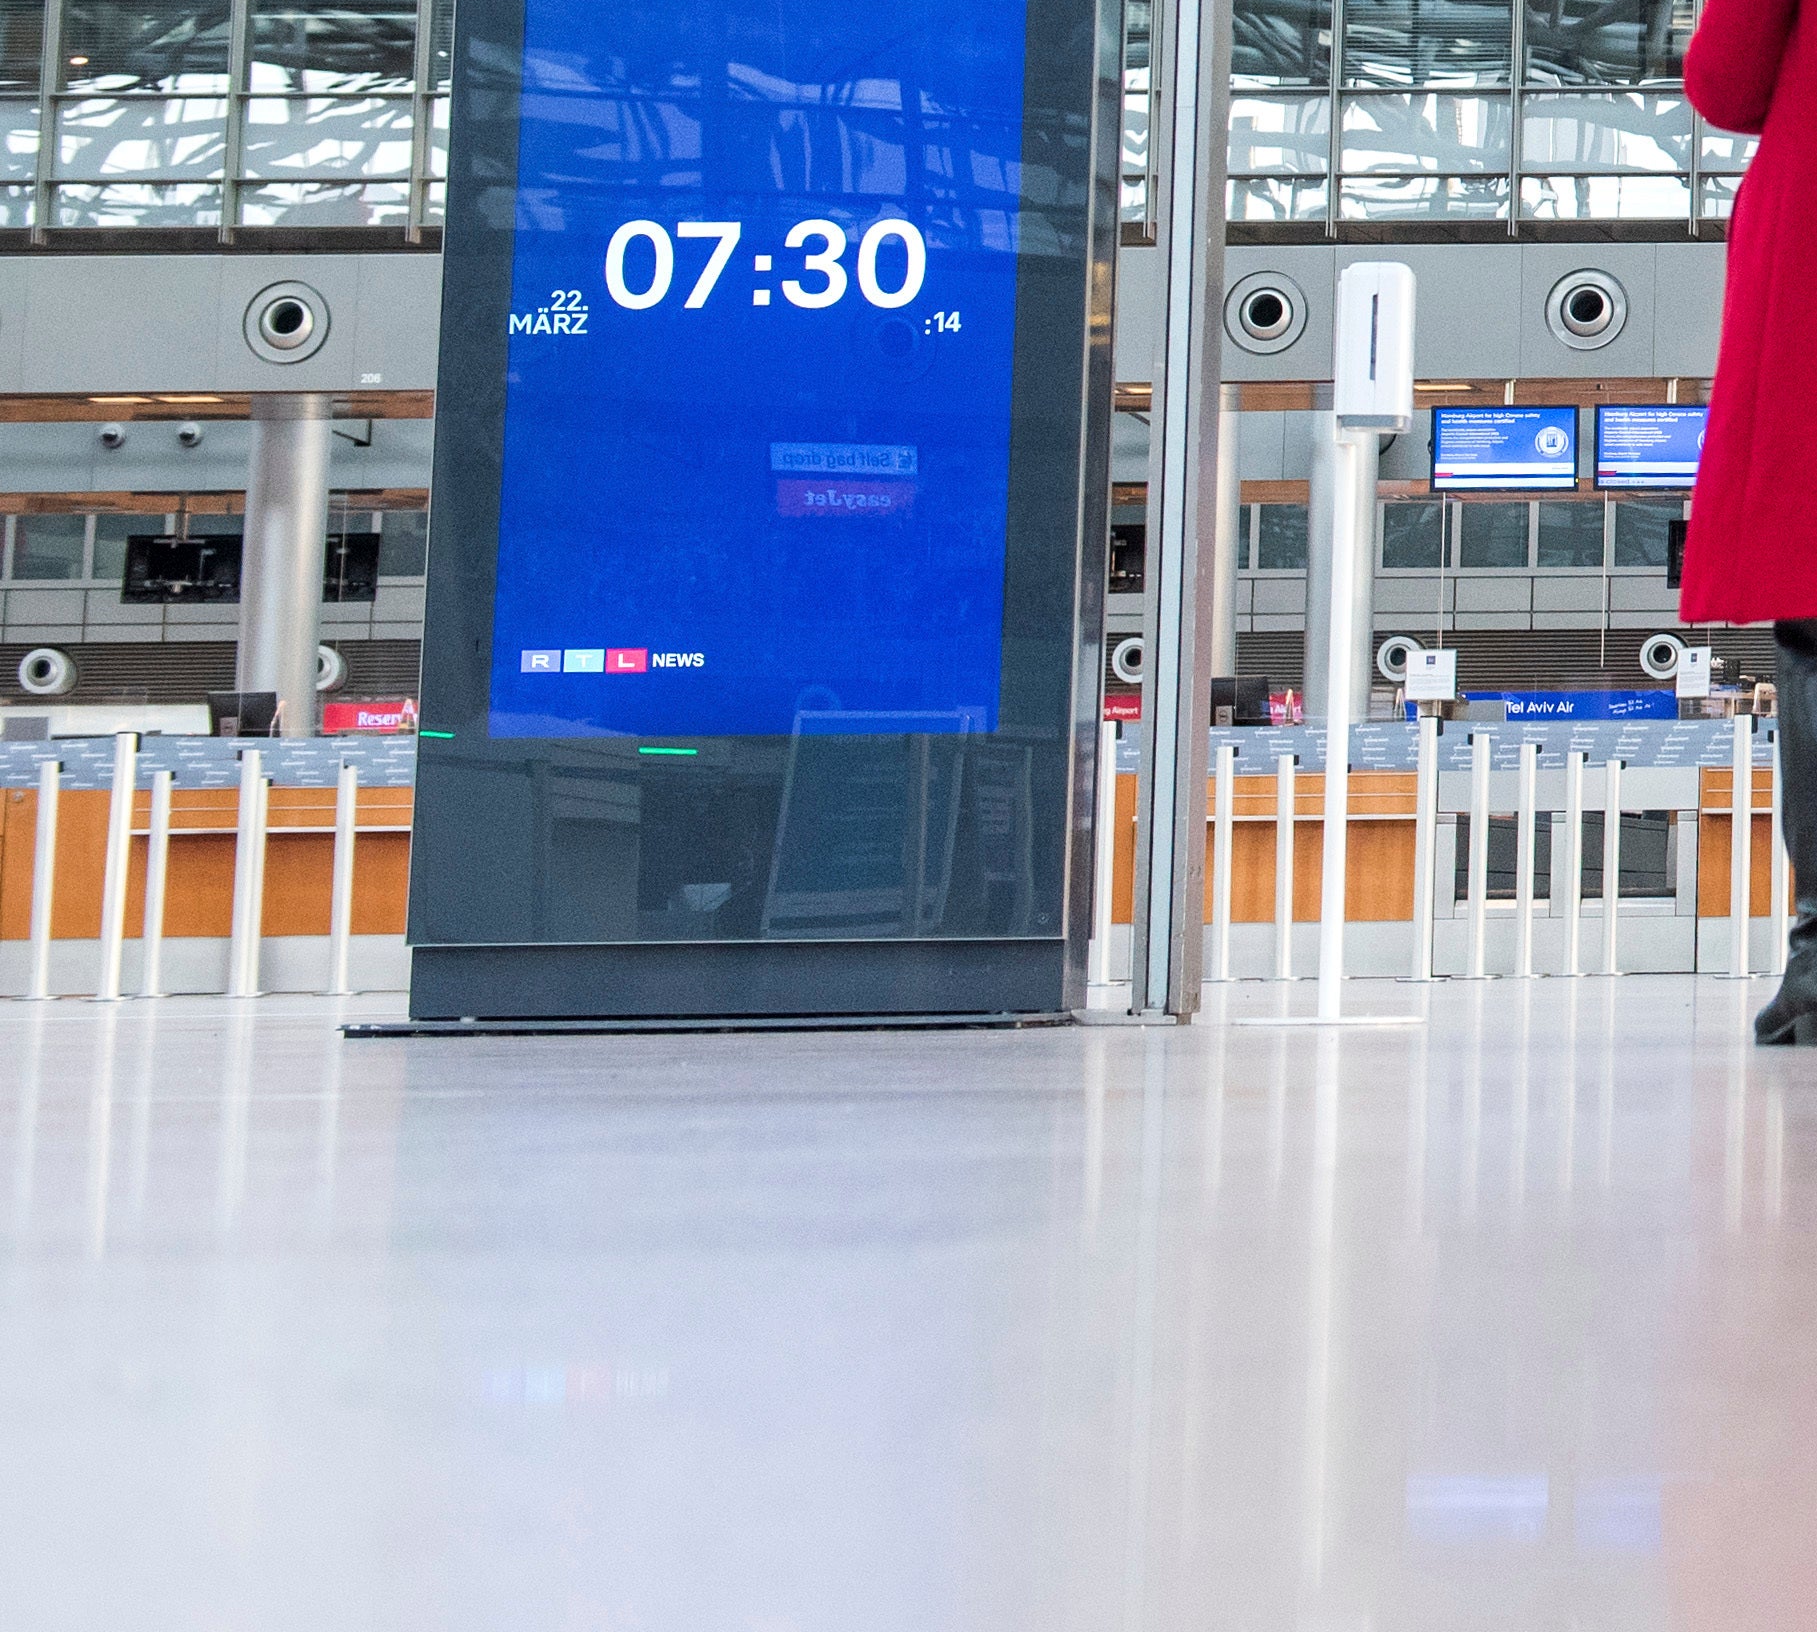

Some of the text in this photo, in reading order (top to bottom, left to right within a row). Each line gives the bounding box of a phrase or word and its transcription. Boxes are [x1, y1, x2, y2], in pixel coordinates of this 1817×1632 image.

[605, 219, 925, 309] 07:30
[551, 290, 588, 311] 22.
[508, 307, 588, 336] MÄRZ
[925, 312, 961, 334] :14
[652, 653, 705, 668] NEWS
[1507, 701, 1574, 713] Tel Aviv Air
